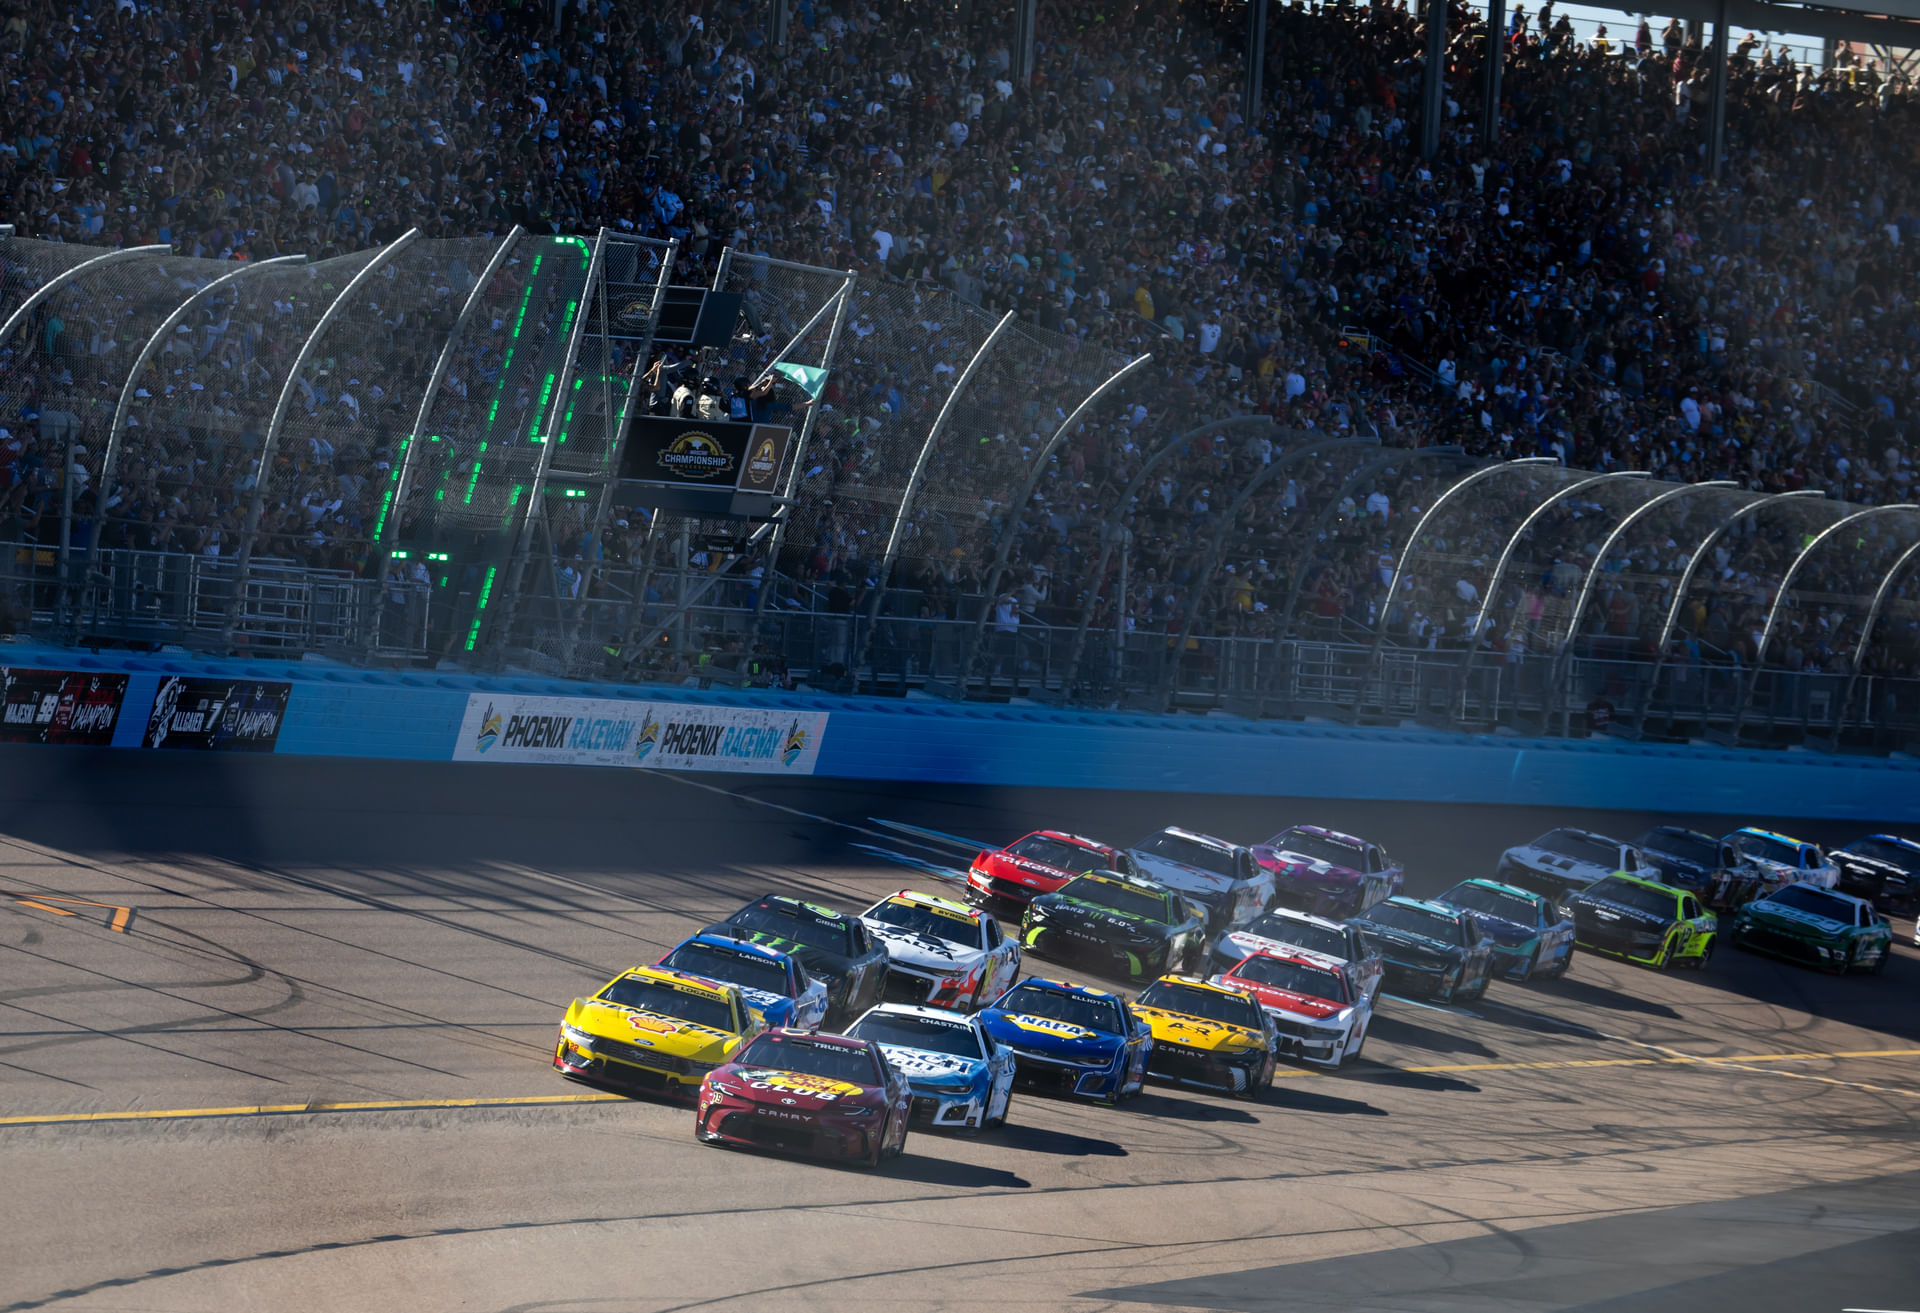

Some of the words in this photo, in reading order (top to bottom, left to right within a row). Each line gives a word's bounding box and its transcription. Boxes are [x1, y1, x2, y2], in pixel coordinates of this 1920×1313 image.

[664, 453, 727, 467] CHAMPIONSHIP
[4, 703, 37, 724] MAJESKI
[35, 695, 60, 723] 98
[170, 711, 205, 732] ALLGAIER
[203, 699, 226, 733] 7
[502, 715, 573, 748] PHOENIX
[567, 717, 636, 752] RACEWAY
[659, 723, 726, 756] PHOENIX
[719, 726, 785, 759] RACEWAY
[1055, 904, 1085, 915] HARD
[1107, 917, 1137, 933] 6.0%
[1065, 929, 1107, 944] CAMRY
[738, 953, 777, 966] LARSON
[1300, 964, 1333, 977] BURTON
[1071, 994, 1108, 1008] ELLIOTT
[1224, 994, 1246, 1005] BELL
[919, 1017, 970, 1032] CHASTAIN
[1020, 1014, 1082, 1035] NAPA
[569, 1042, 579, 1053] 22
[813, 1041, 850, 1054] TRUEX
[851, 1049, 867, 1057] JR
[1158, 1045, 1206, 1059] CAMRY
[713, 1092, 723, 1103] 19
[750, 1081, 838, 1101] CLUB
[758, 1108, 814, 1122] CAMRY
